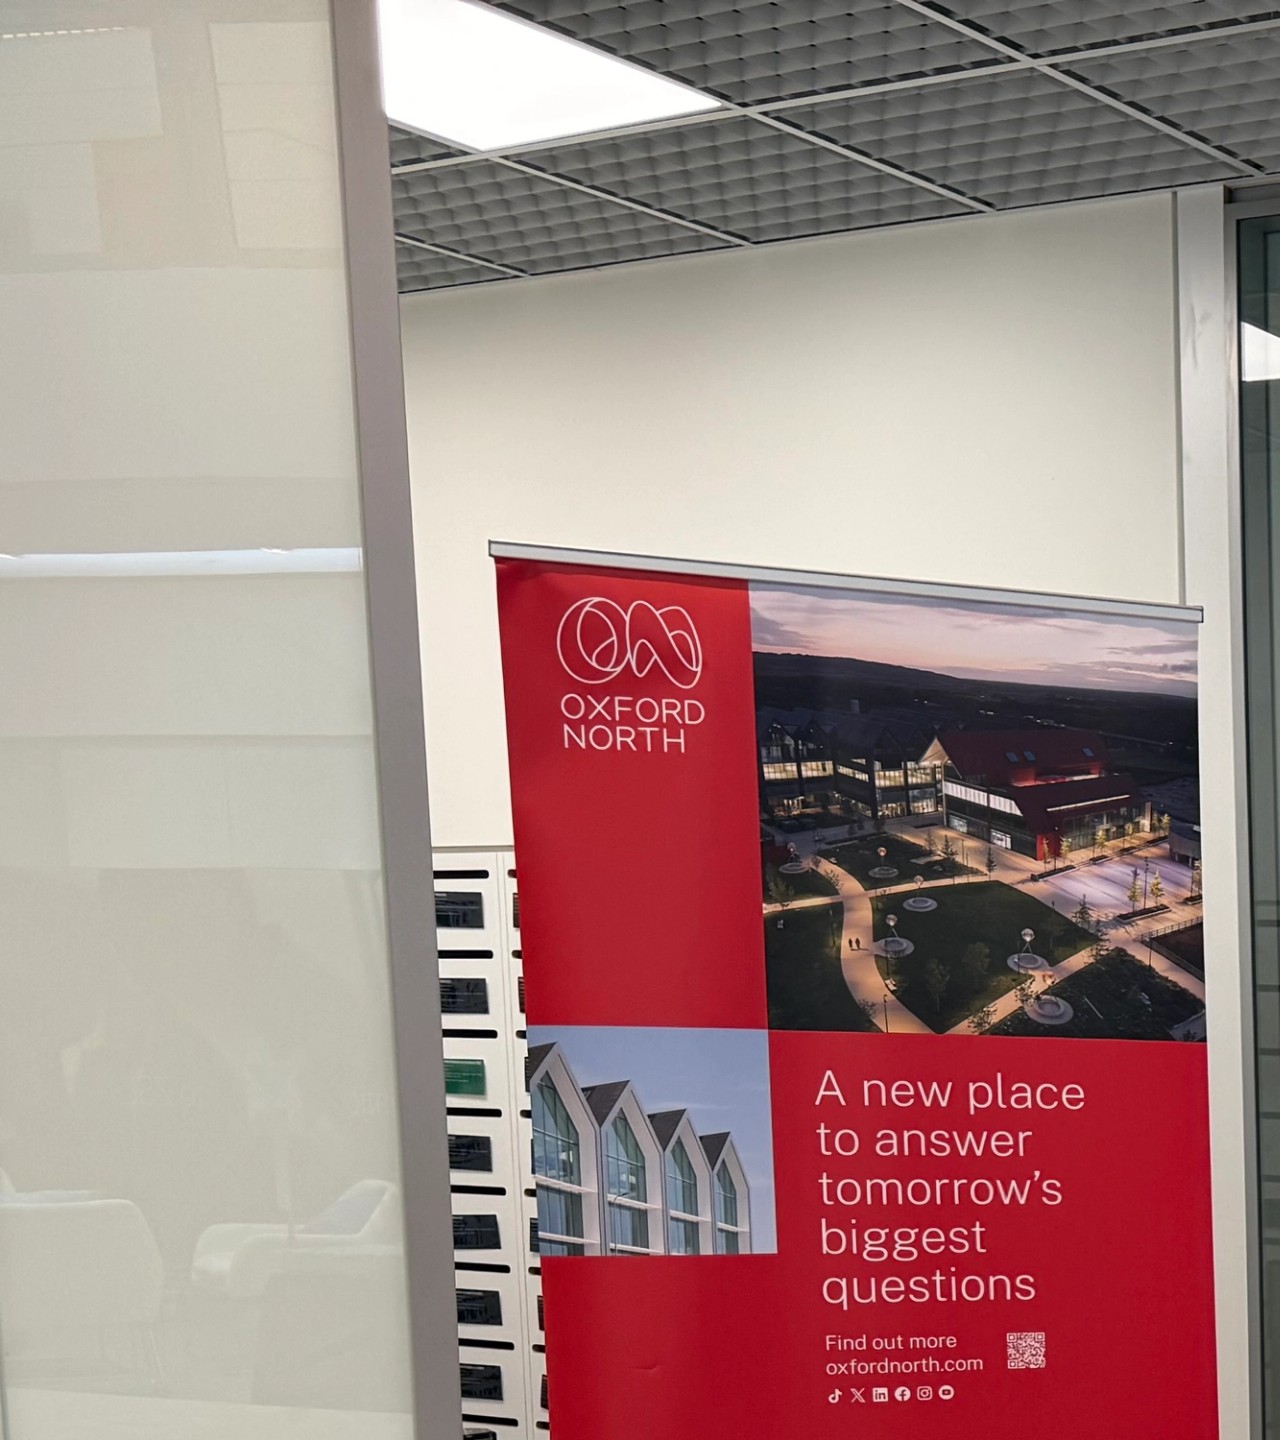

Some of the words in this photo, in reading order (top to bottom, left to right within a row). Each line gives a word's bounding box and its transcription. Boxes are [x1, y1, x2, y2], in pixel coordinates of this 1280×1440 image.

[560, 693, 706, 725] OXFORD
[563, 723, 686, 754] NORTH
[815, 1069, 846, 1106] A
[863, 1078, 953, 1108] new
[969, 1072, 1085, 1116] place
[816, 1122, 860, 1156] to
[875, 1128, 1033, 1157] answer
[818, 1170, 1063, 1206] tomorrow’s
[820, 1217, 987, 1262] biggest
[822, 1266, 1036, 1311] questions
[825, 1334, 867, 1351] Find
[872, 1335, 904, 1350] out
[909, 1335, 957, 1349] more
[826, 1356, 984, 1376] oxfordnorth.com
